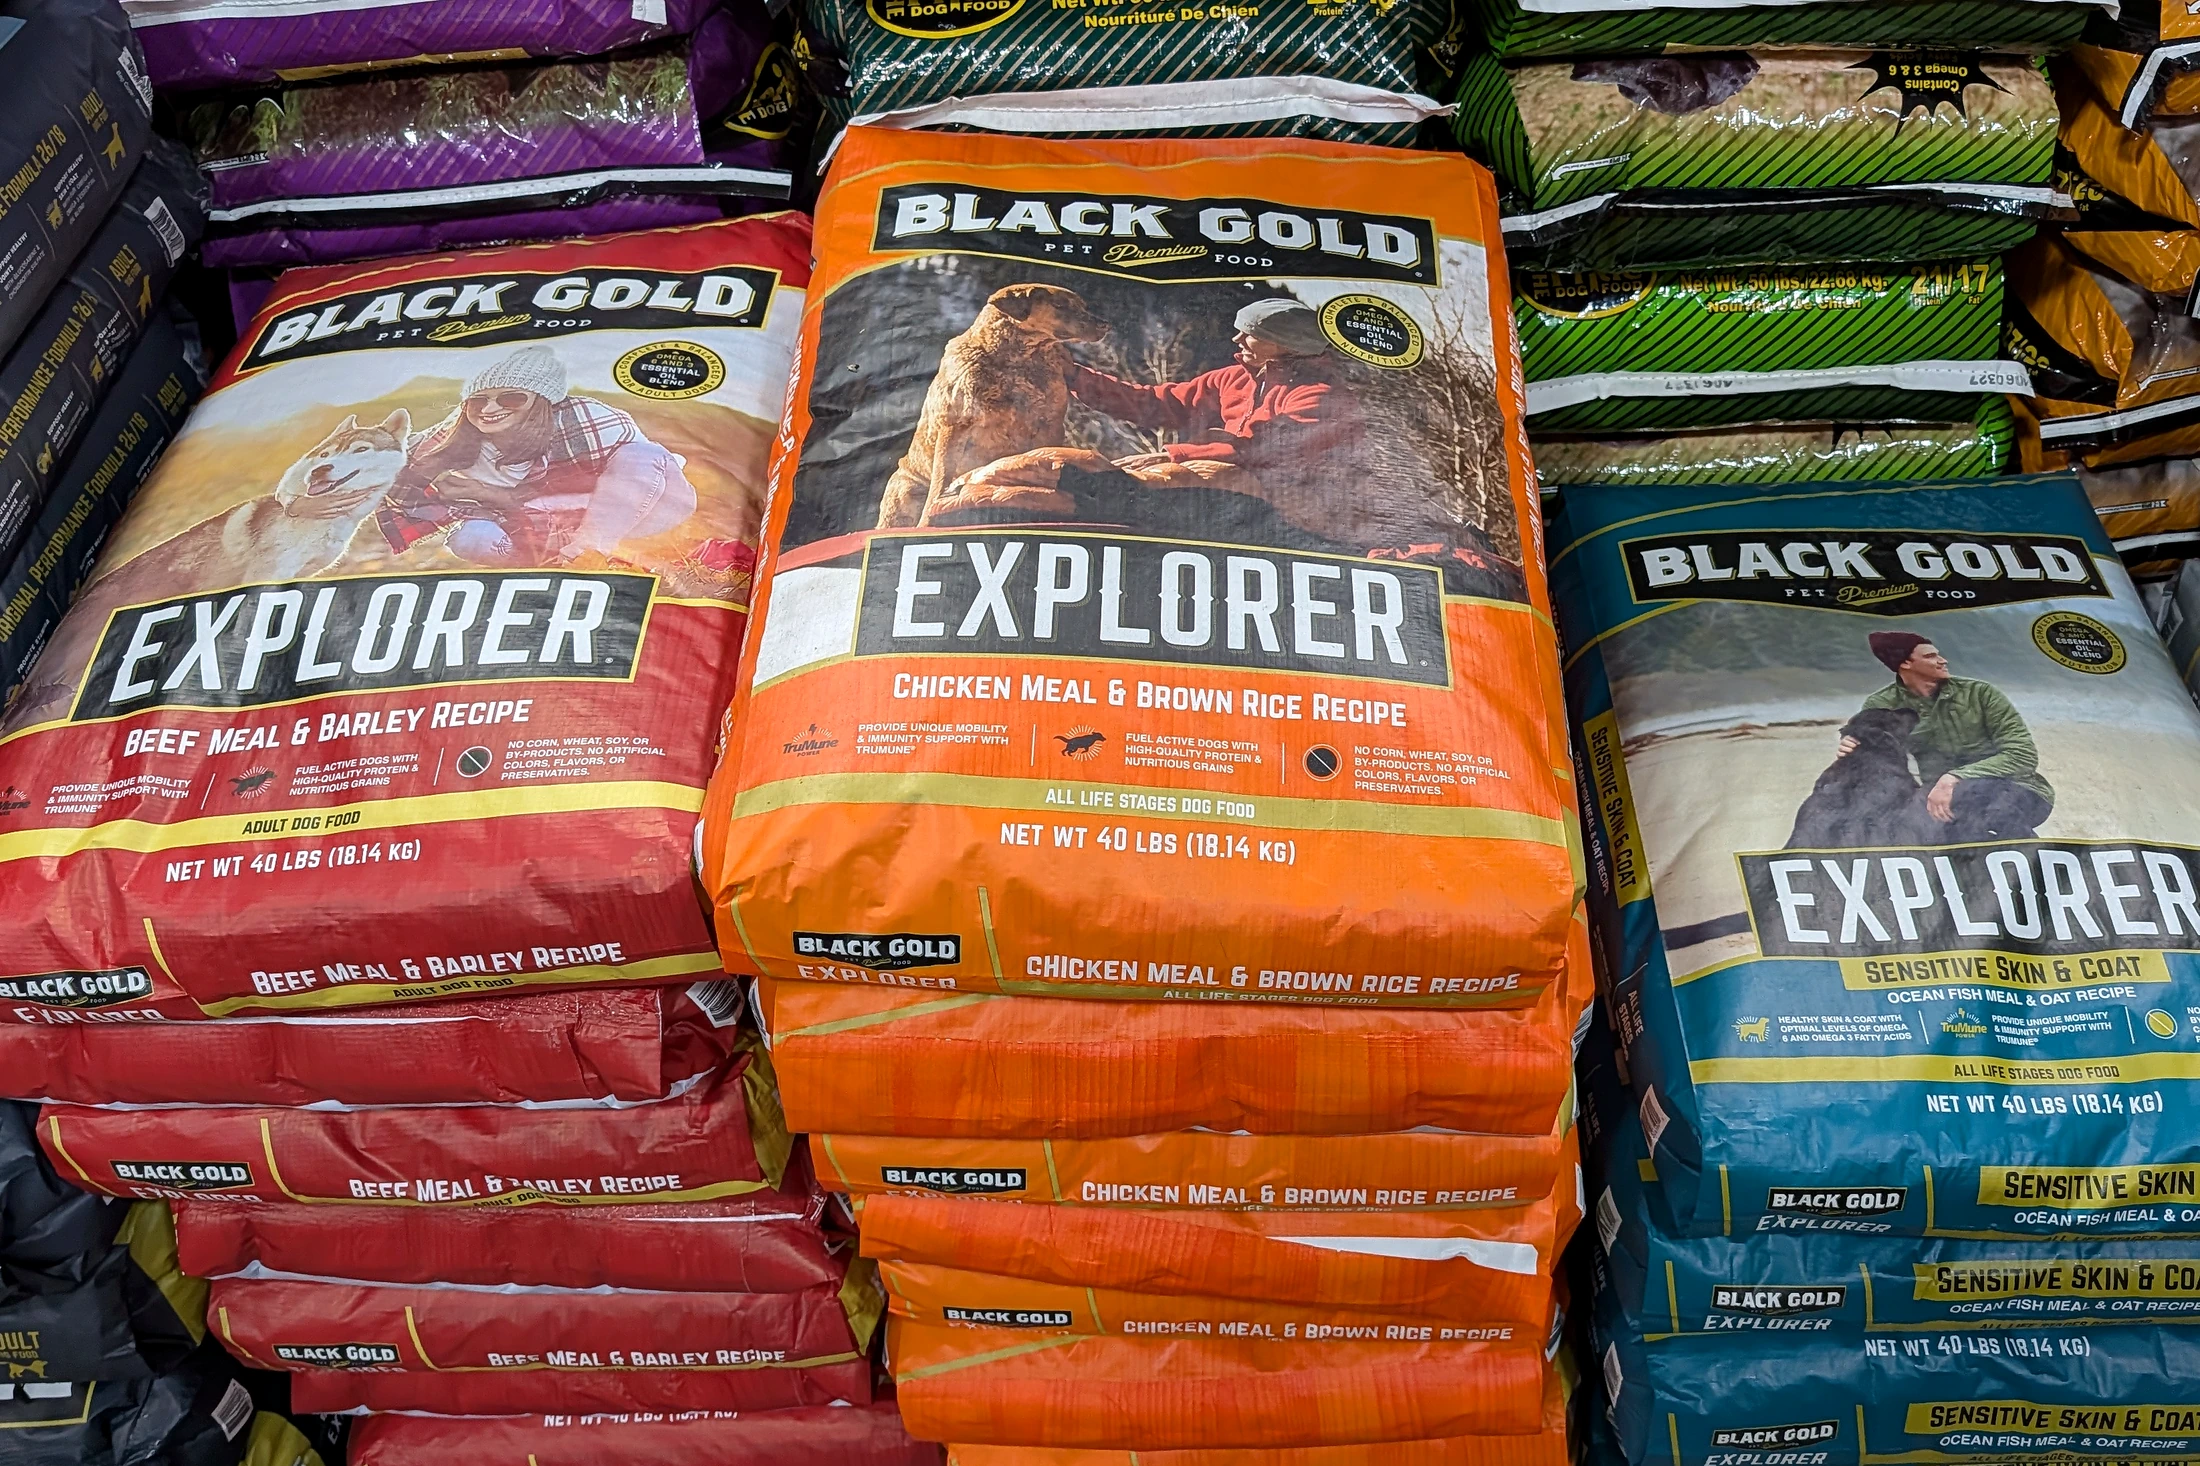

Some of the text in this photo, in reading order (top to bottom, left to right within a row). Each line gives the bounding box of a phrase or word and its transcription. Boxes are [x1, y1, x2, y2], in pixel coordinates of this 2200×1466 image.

[910, 1, 1010, 15] DOG FOOD
[1181, 8, 1205, 19] De
[1211, 4, 1259, 18] Chien
[1313, 6, 1343, 16] Protein
[1889, 65, 1968, 77] Omega 3 & 6
[1905, 80, 1960, 92] Contains
[893, 193, 1419, 267] BLACK GOLD
[1044, 243, 1274, 268] PET Premium FOOD
[1679, 275, 1708, 292] Net
[1712, 275, 1743, 291] Wt.
[1748, 273, 1769, 291] 50
[1861, 272, 1888, 290] kg.
[1911, 264, 1990, 295] 21/17
[1913, 296, 1980, 306] Protein Fat
[258, 274, 756, 358] BLACK GOLD
[377, 313, 592, 342] PET Premium FOOD
[156, 372, 185, 411] ADULT
[29, 493, 94, 585] PERFORMANCE
[84, 446, 127, 502] FORMULA
[118, 411, 149, 454] 26/18
[1640, 542, 2089, 588] BLACK GOLD
[891, 541, 1409, 665] EXPLORER
[1785, 583, 1977, 604] PET Premium FOOD
[109, 578, 612, 704] EXPLORER
[894, 673, 1406, 727] CHICKEN MEAL & BROWN RICE RECIPE
[124, 699, 533, 757] BEEF MEAL & BARLEY RECIPE
[858, 723, 1008, 733] PROVIDE UNIQUE MOBILITY
[783, 738, 838, 754] TruMune
[857, 734, 1009, 745] & IMMUNITY SUPPORT WITH
[1126, 733, 1258, 751] FUEL ACTIVE DOGS WITH
[1125, 756, 1234, 774] NUTRITIOUS GRAINS
[1126, 745, 1261, 763] HIGH-QUALITY PROTEIN &
[1045, 788, 1255, 819] ALL LIFE STAGES DOG FOOD
[242, 811, 361, 835] ADULT DOG FOOD
[1001, 823, 1295, 865] NET WT 40 LBS (18.14 KG)
[166, 839, 420, 882] NET WT 40 LBS (18.14 KG)
[1769, 849, 2200, 944] EXPLORER
[798, 938, 955, 959] BLACK GOLD
[251, 942, 626, 994] BEEF MEAL & BARLEY RECIPE
[1027, 955, 1520, 993] CHICKEN MEAL & BROWN RICE RECIPE
[1864, 956, 2141, 984] SENSITIVE SKIN & COAT
[0, 972, 148, 997] BLACK GOLD
[1888, 986, 2137, 1006] OCEAN FISH MEAL & OAT RECIPE
[1780, 1025, 1821, 1033] OPTIMAL
[1873, 1023, 1908, 1032] OMEGA
[1878, 1014, 1902, 1022] WITH
[1941, 1023, 1987, 1034] TruMune
[1790, 1034, 1810, 1042] AND
[1884, 1032, 1912, 1041] ACIDS
[1954, 1064, 2120, 1079] ALL LIFE STAGES DOG FOOD
[1927, 1091, 2163, 1115] NET WT 40 LBS (18.14 KG)
[2004, 1170, 2194, 1200] SENSITIVE SKIN
[1772, 1193, 1900, 1211] BLACK GOLD
[1756, 1213, 1891, 1232] EXPLORER
